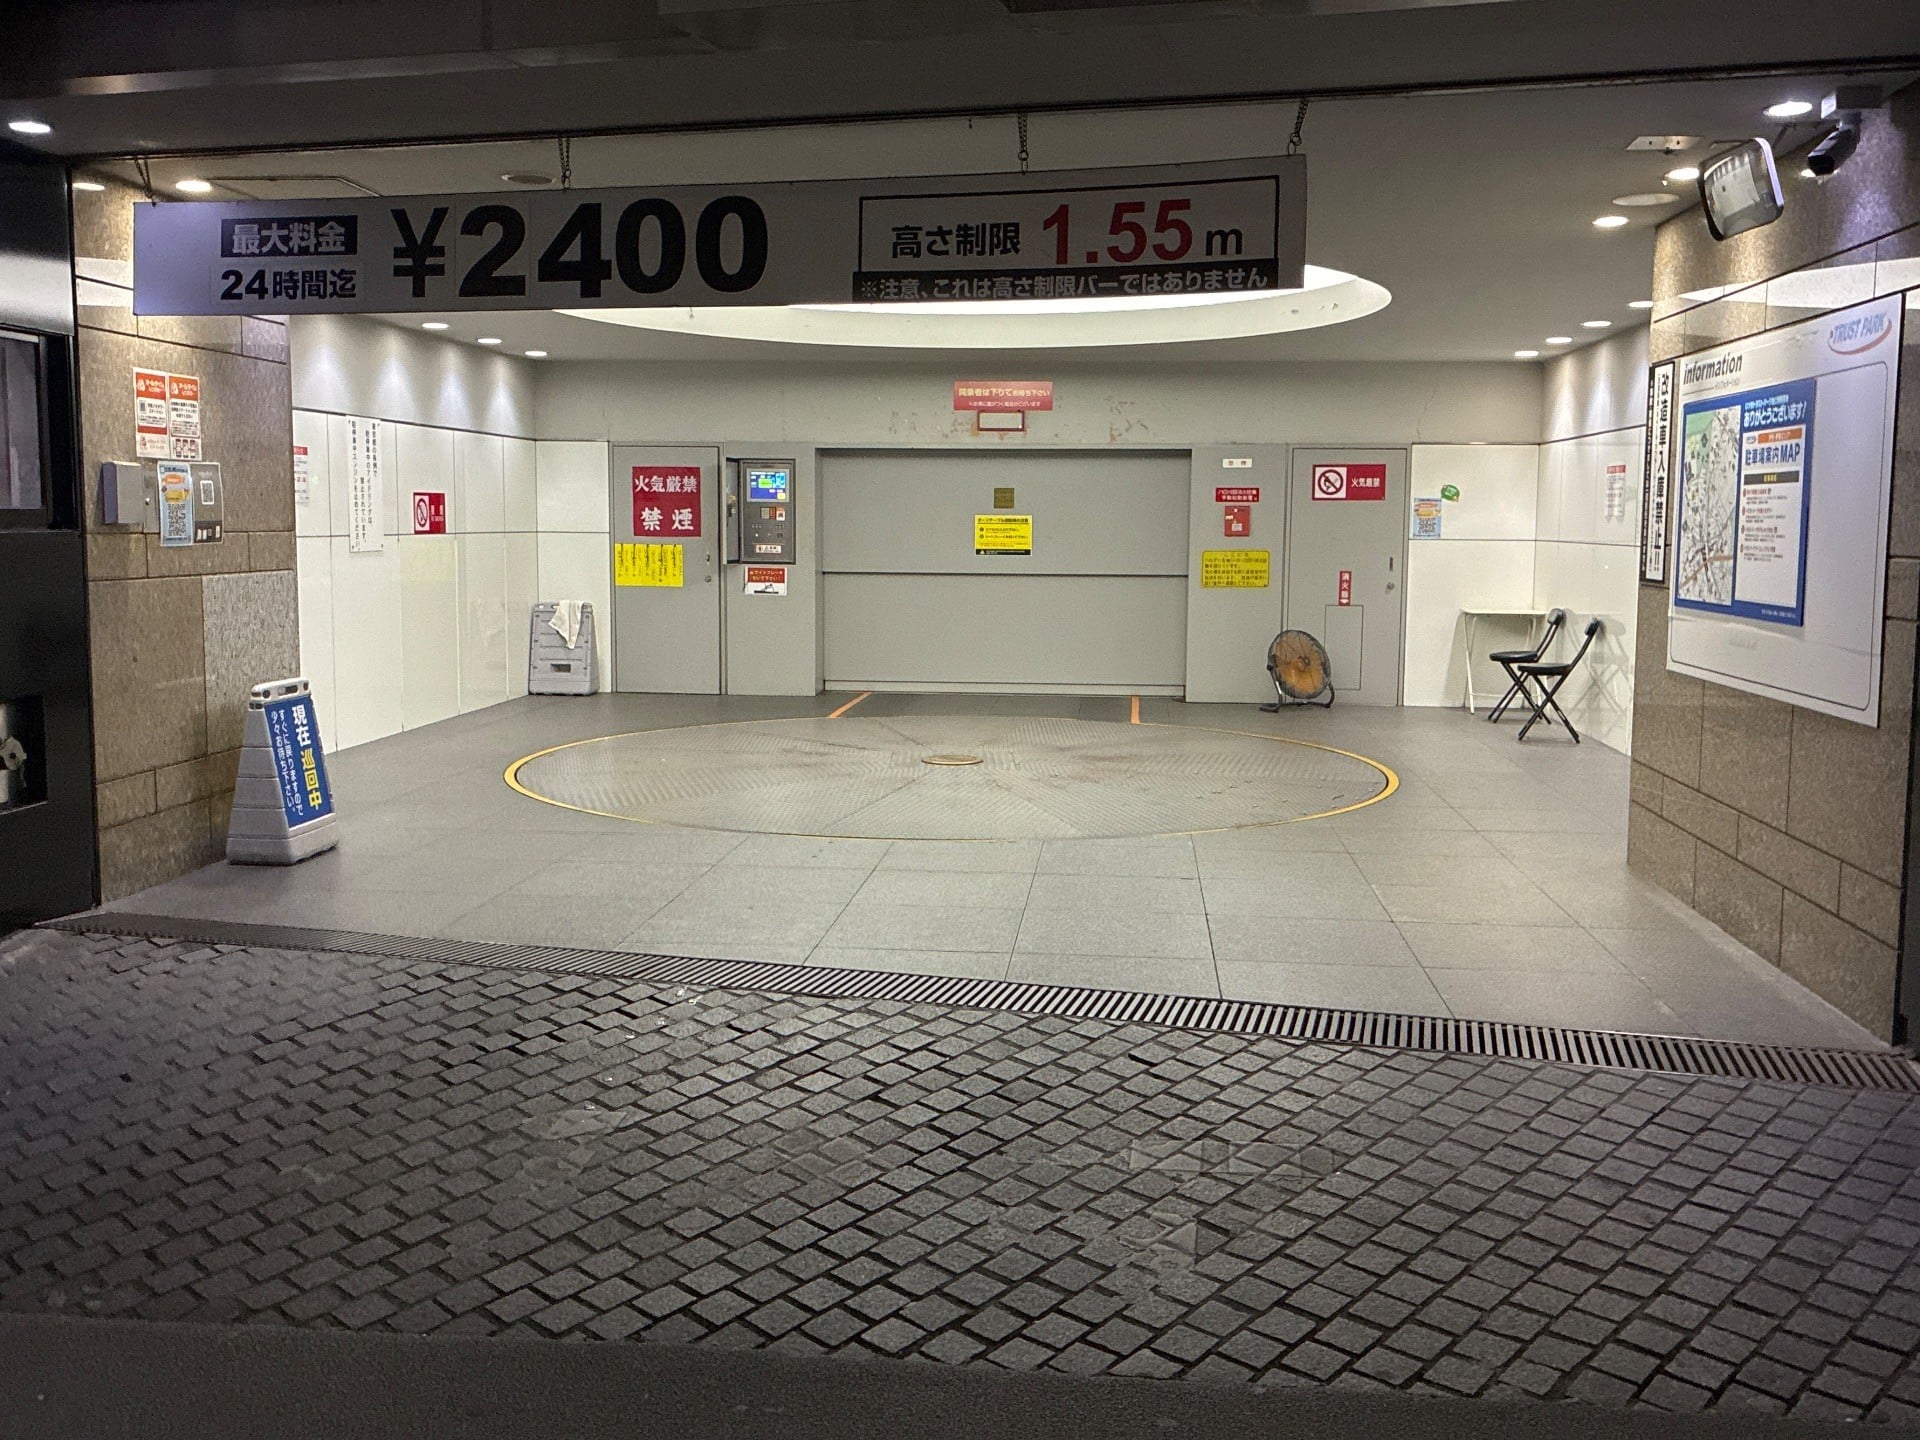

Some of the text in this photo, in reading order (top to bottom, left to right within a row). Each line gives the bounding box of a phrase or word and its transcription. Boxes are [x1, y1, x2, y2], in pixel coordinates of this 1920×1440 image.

[231, 218, 346, 254] 最大料金
[391, 195, 768, 299] ¥2400
[891, 199, 1243, 265] 高さ制限 1.55 m
[220, 265, 357, 300] 24時間迄
[861, 268, 1268, 300] ※注意、これは高さ制限バーではありません
[1833, 312, 1888, 343] TRUST PARK
[1683, 353, 1743, 385] information
[634, 475, 698, 493] 火気厳禁
[292, 704, 322, 810] 現在巡回中
